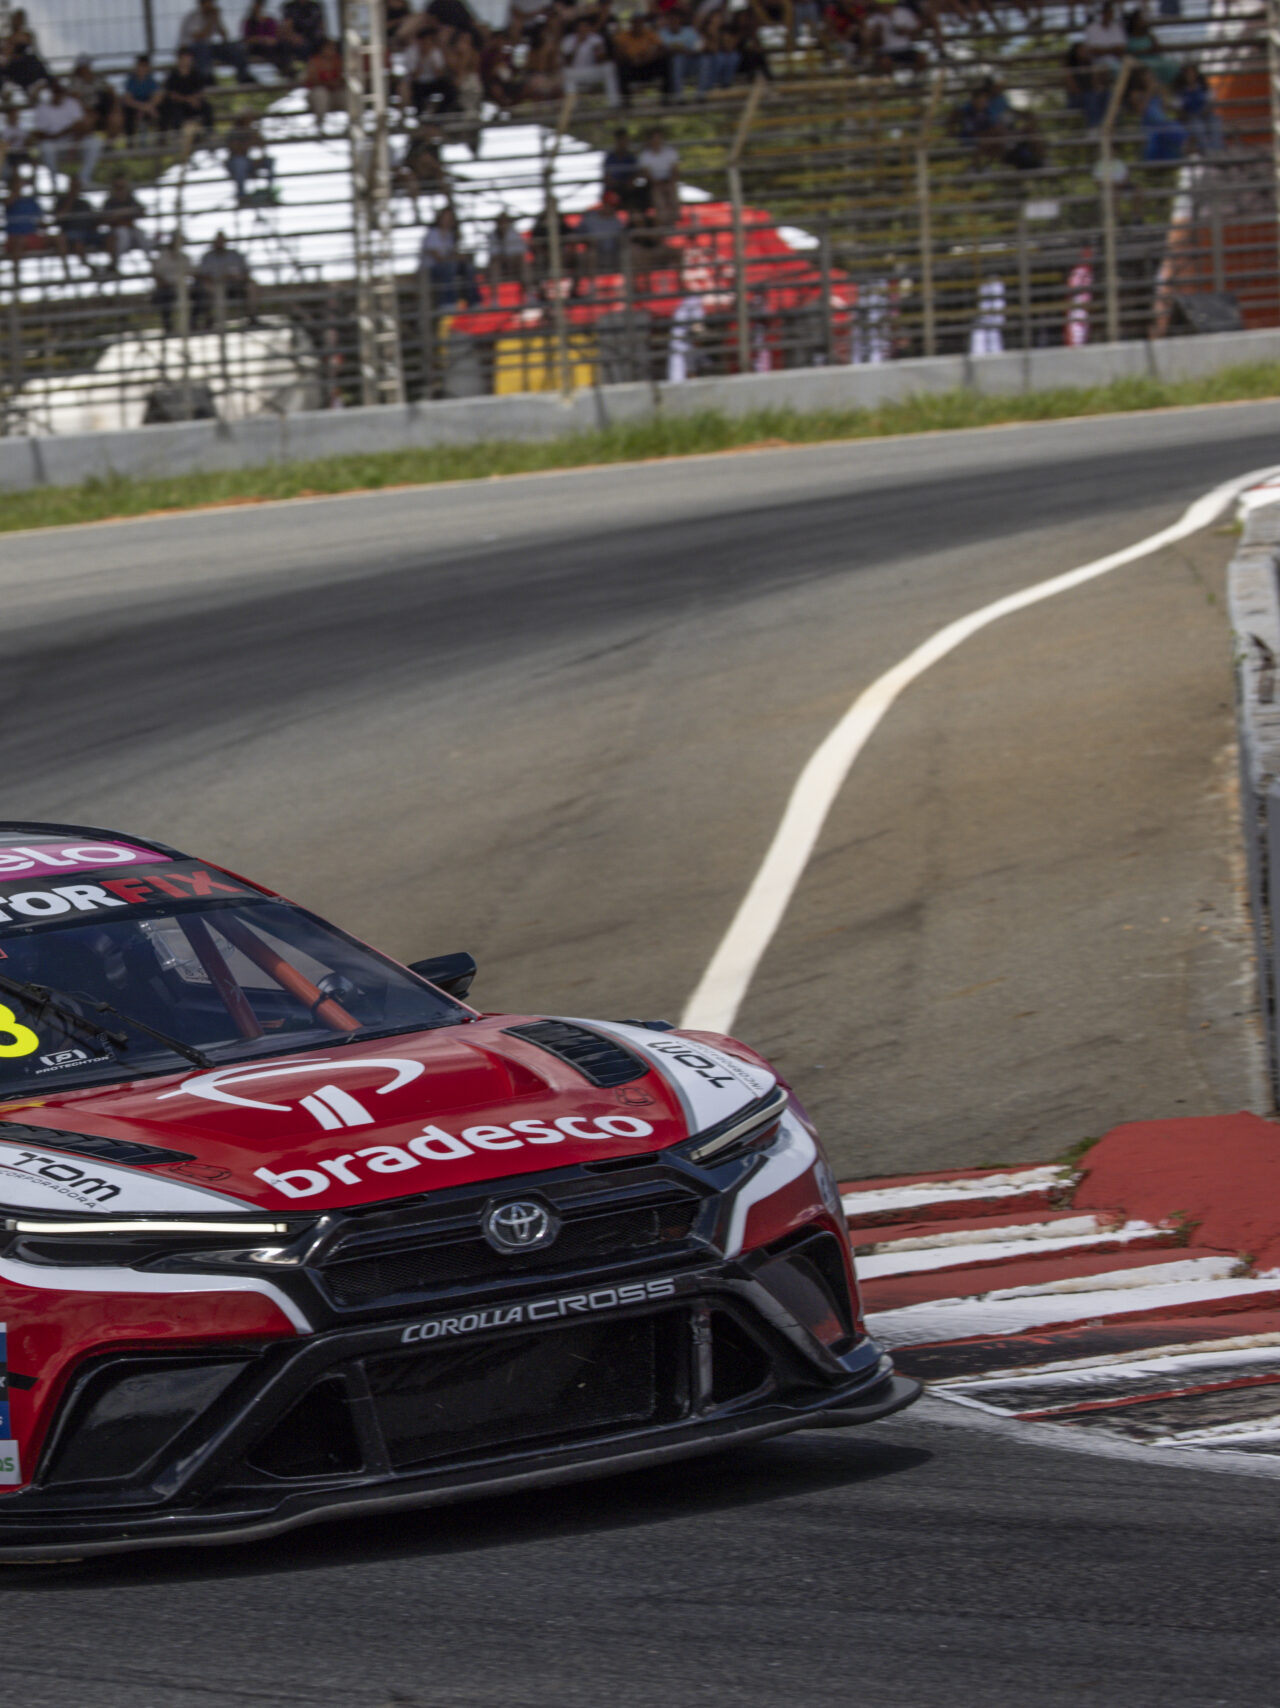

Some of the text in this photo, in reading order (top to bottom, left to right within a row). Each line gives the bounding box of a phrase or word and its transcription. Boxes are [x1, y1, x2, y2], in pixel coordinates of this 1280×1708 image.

[253, 1114, 653, 1199] bradesco
[401, 1278, 676, 1344] COROLLA CROSS
